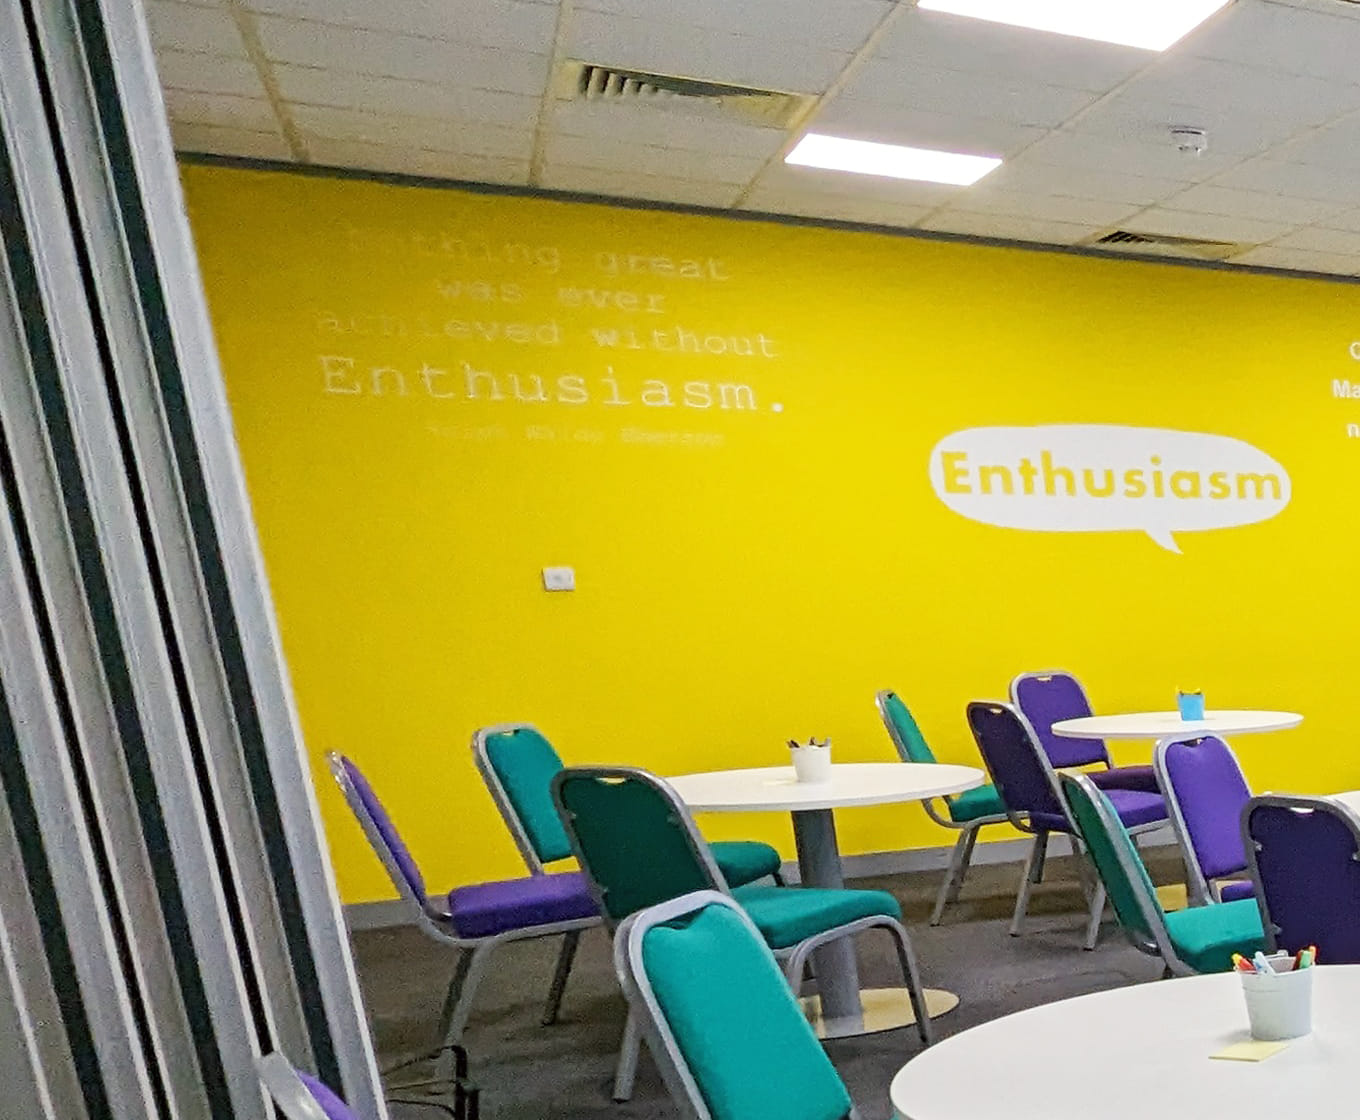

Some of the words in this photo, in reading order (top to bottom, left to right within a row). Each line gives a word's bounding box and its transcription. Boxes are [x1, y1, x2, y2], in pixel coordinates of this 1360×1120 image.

[596, 250, 732, 282] great
[437, 278, 528, 304] was
[556, 286, 668, 315] ever
[591, 324, 777, 357] without
[317, 354, 787, 415] Enthusiasm.
[941, 449, 1282, 500] Enthusiasm
